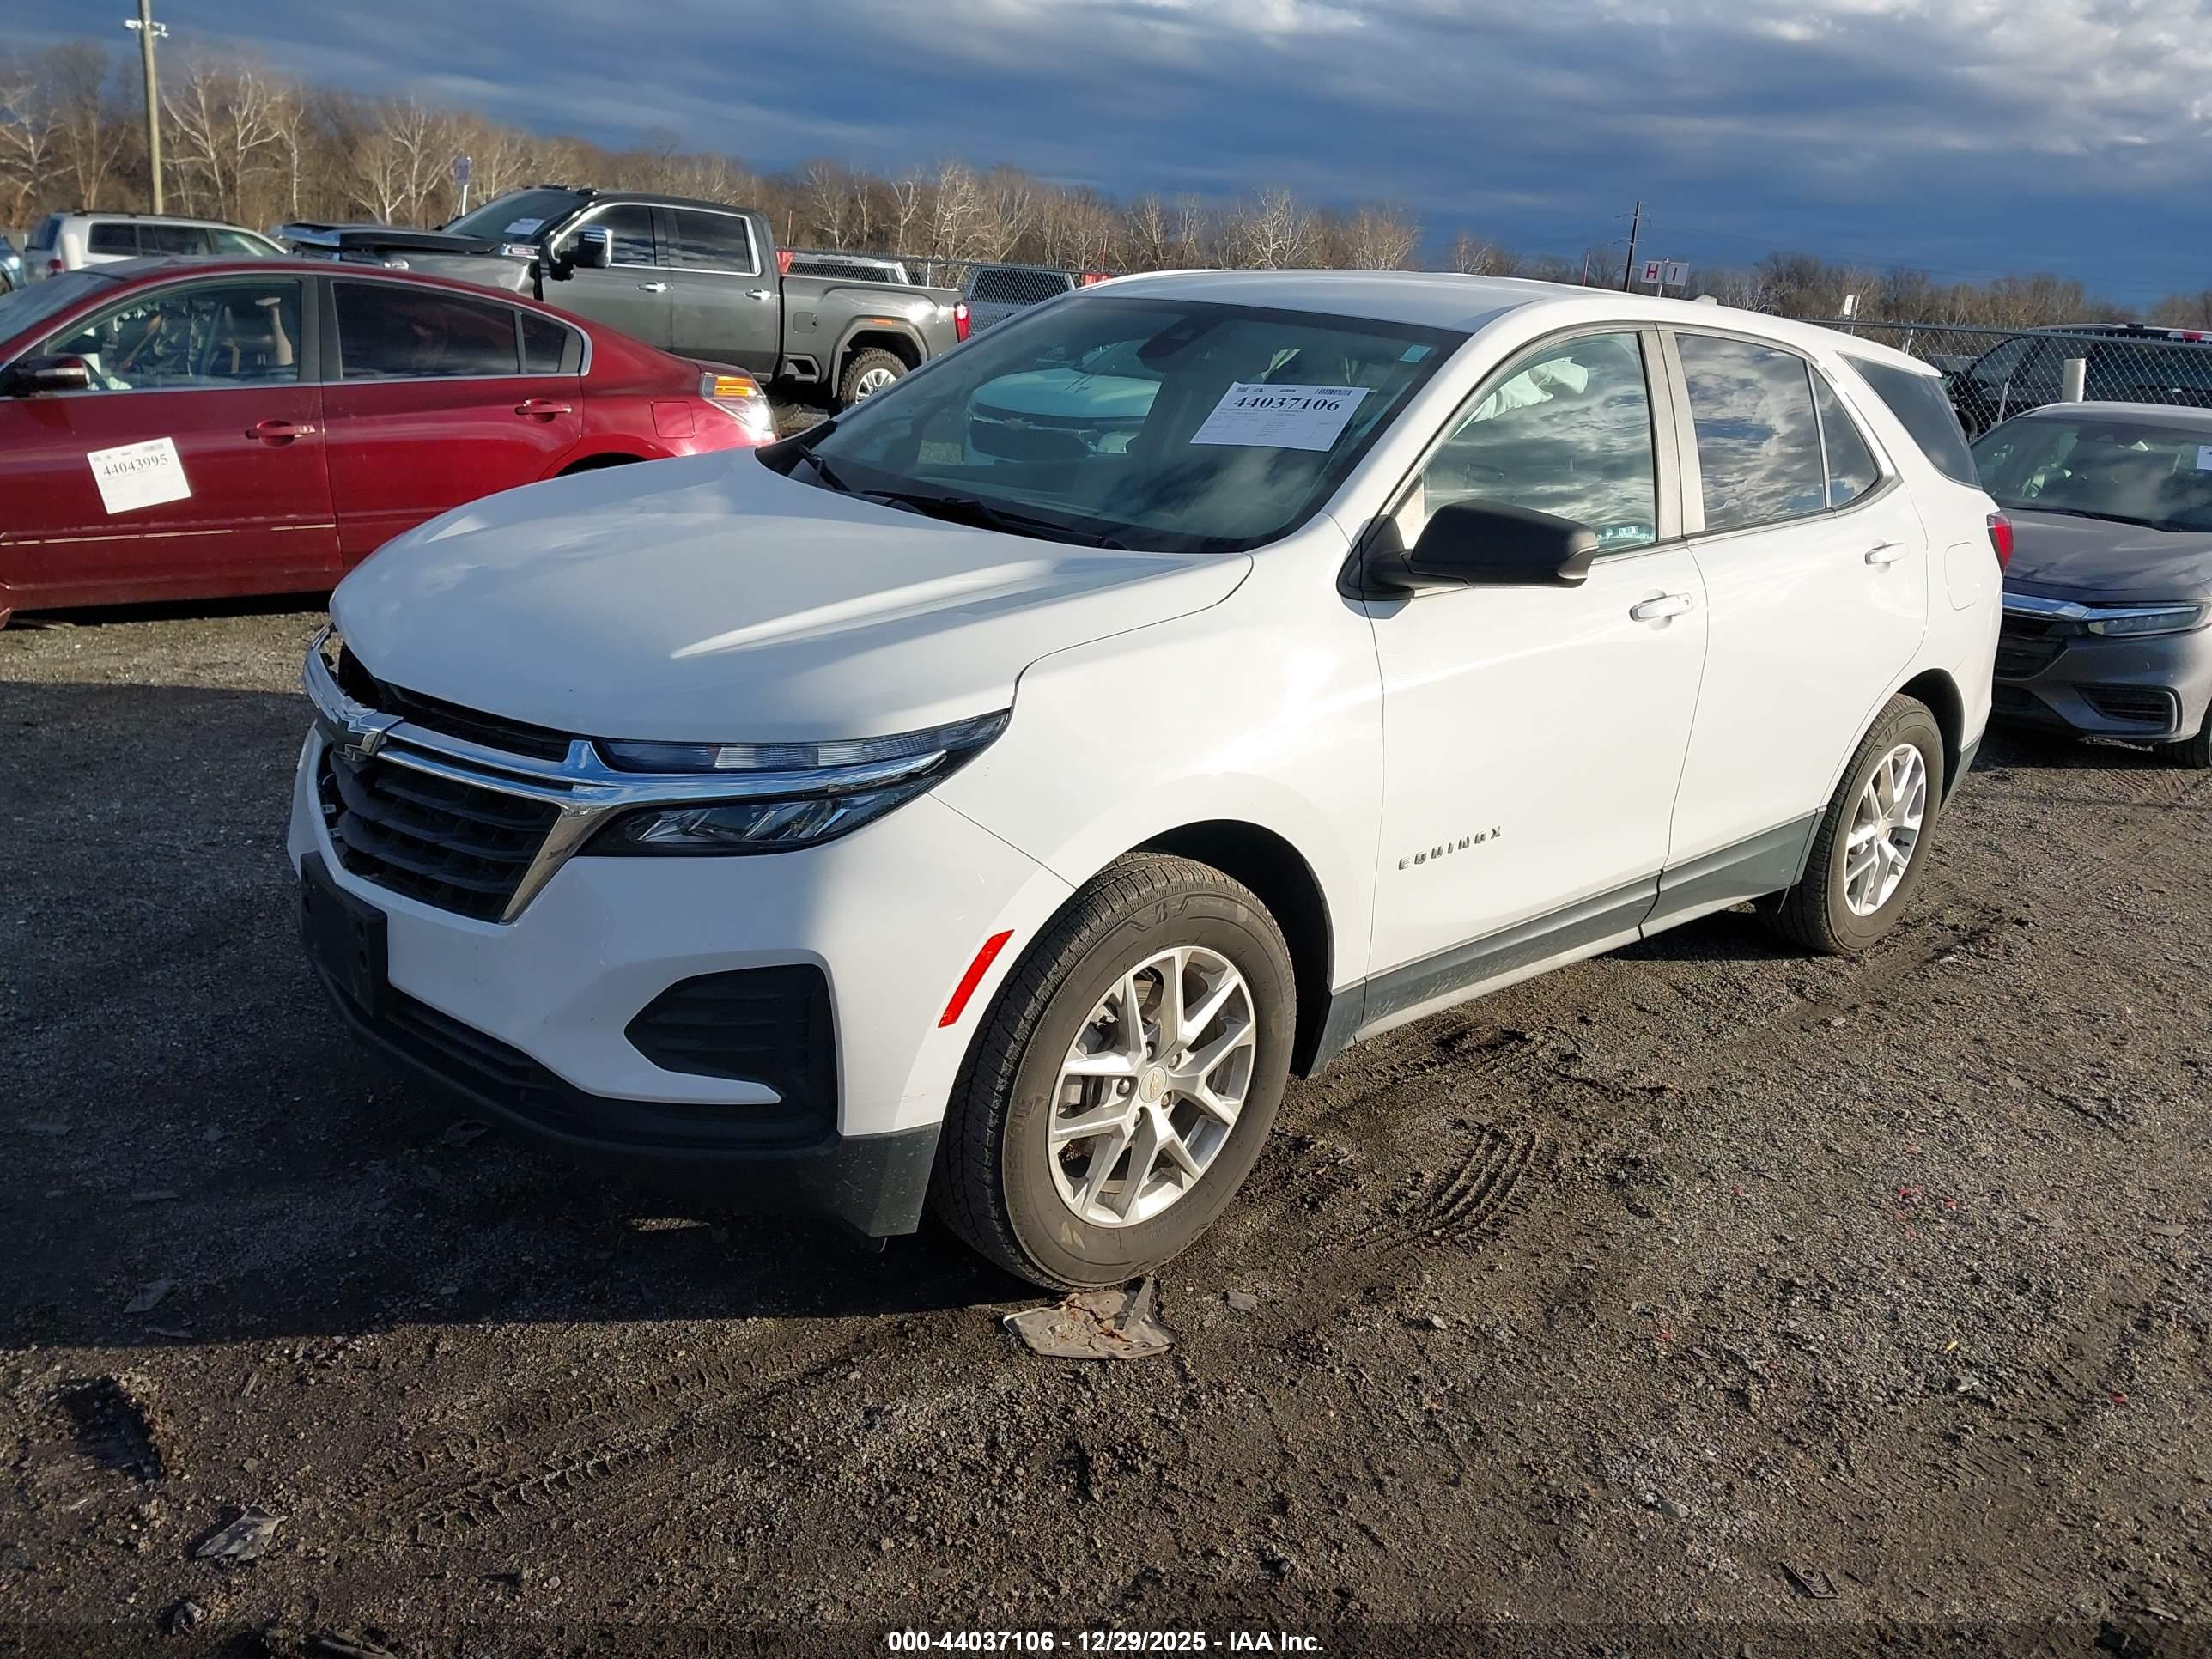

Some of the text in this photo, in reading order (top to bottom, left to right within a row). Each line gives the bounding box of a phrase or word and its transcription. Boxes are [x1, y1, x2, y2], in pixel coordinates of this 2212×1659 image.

[1645, 264, 1659, 280] H
[1233, 397, 1344, 412] 44037106
[103, 453, 169, 477] 44043995
[1398, 825, 1502, 871] EQUINOX
